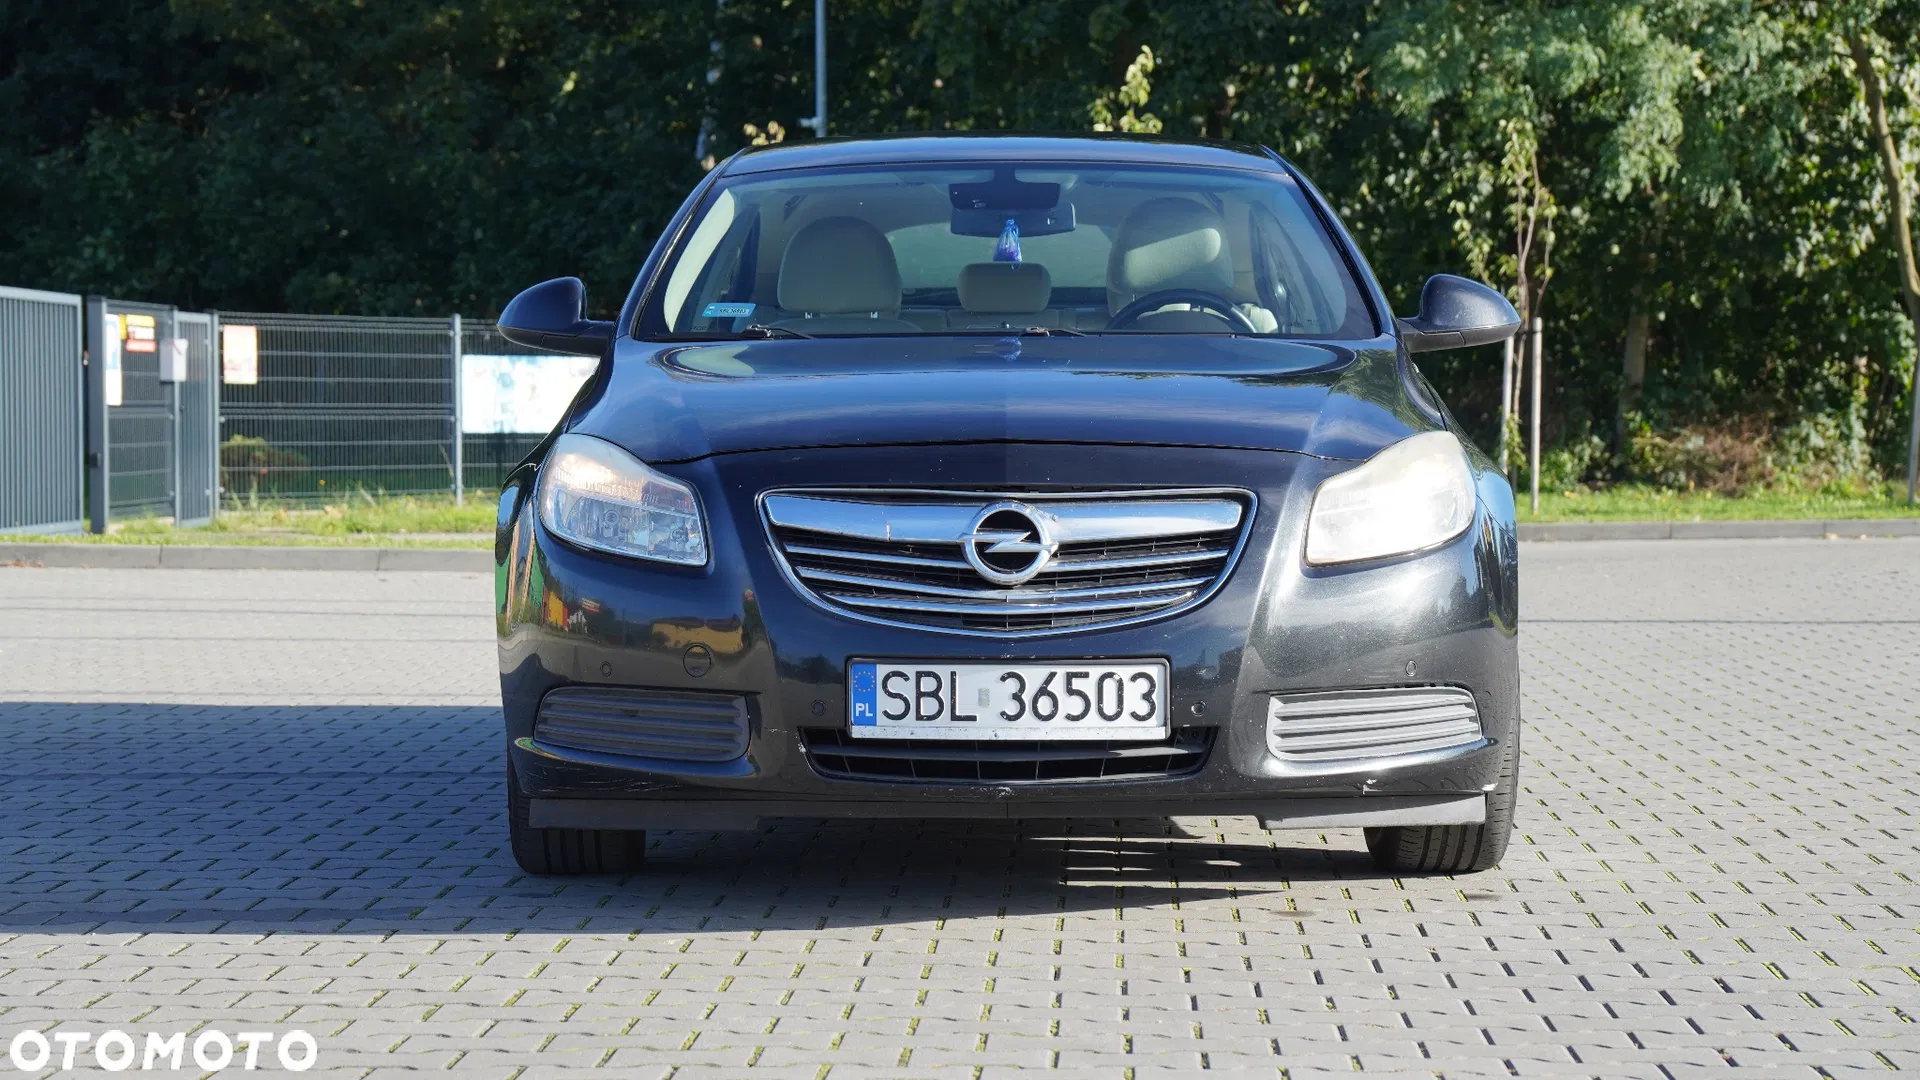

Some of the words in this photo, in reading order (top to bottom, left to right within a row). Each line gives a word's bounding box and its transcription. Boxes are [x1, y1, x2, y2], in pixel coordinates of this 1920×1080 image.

[855, 703, 874, 717] PL
[881, 670, 978, 722] SBL
[999, 671, 1157, 723] 36503
